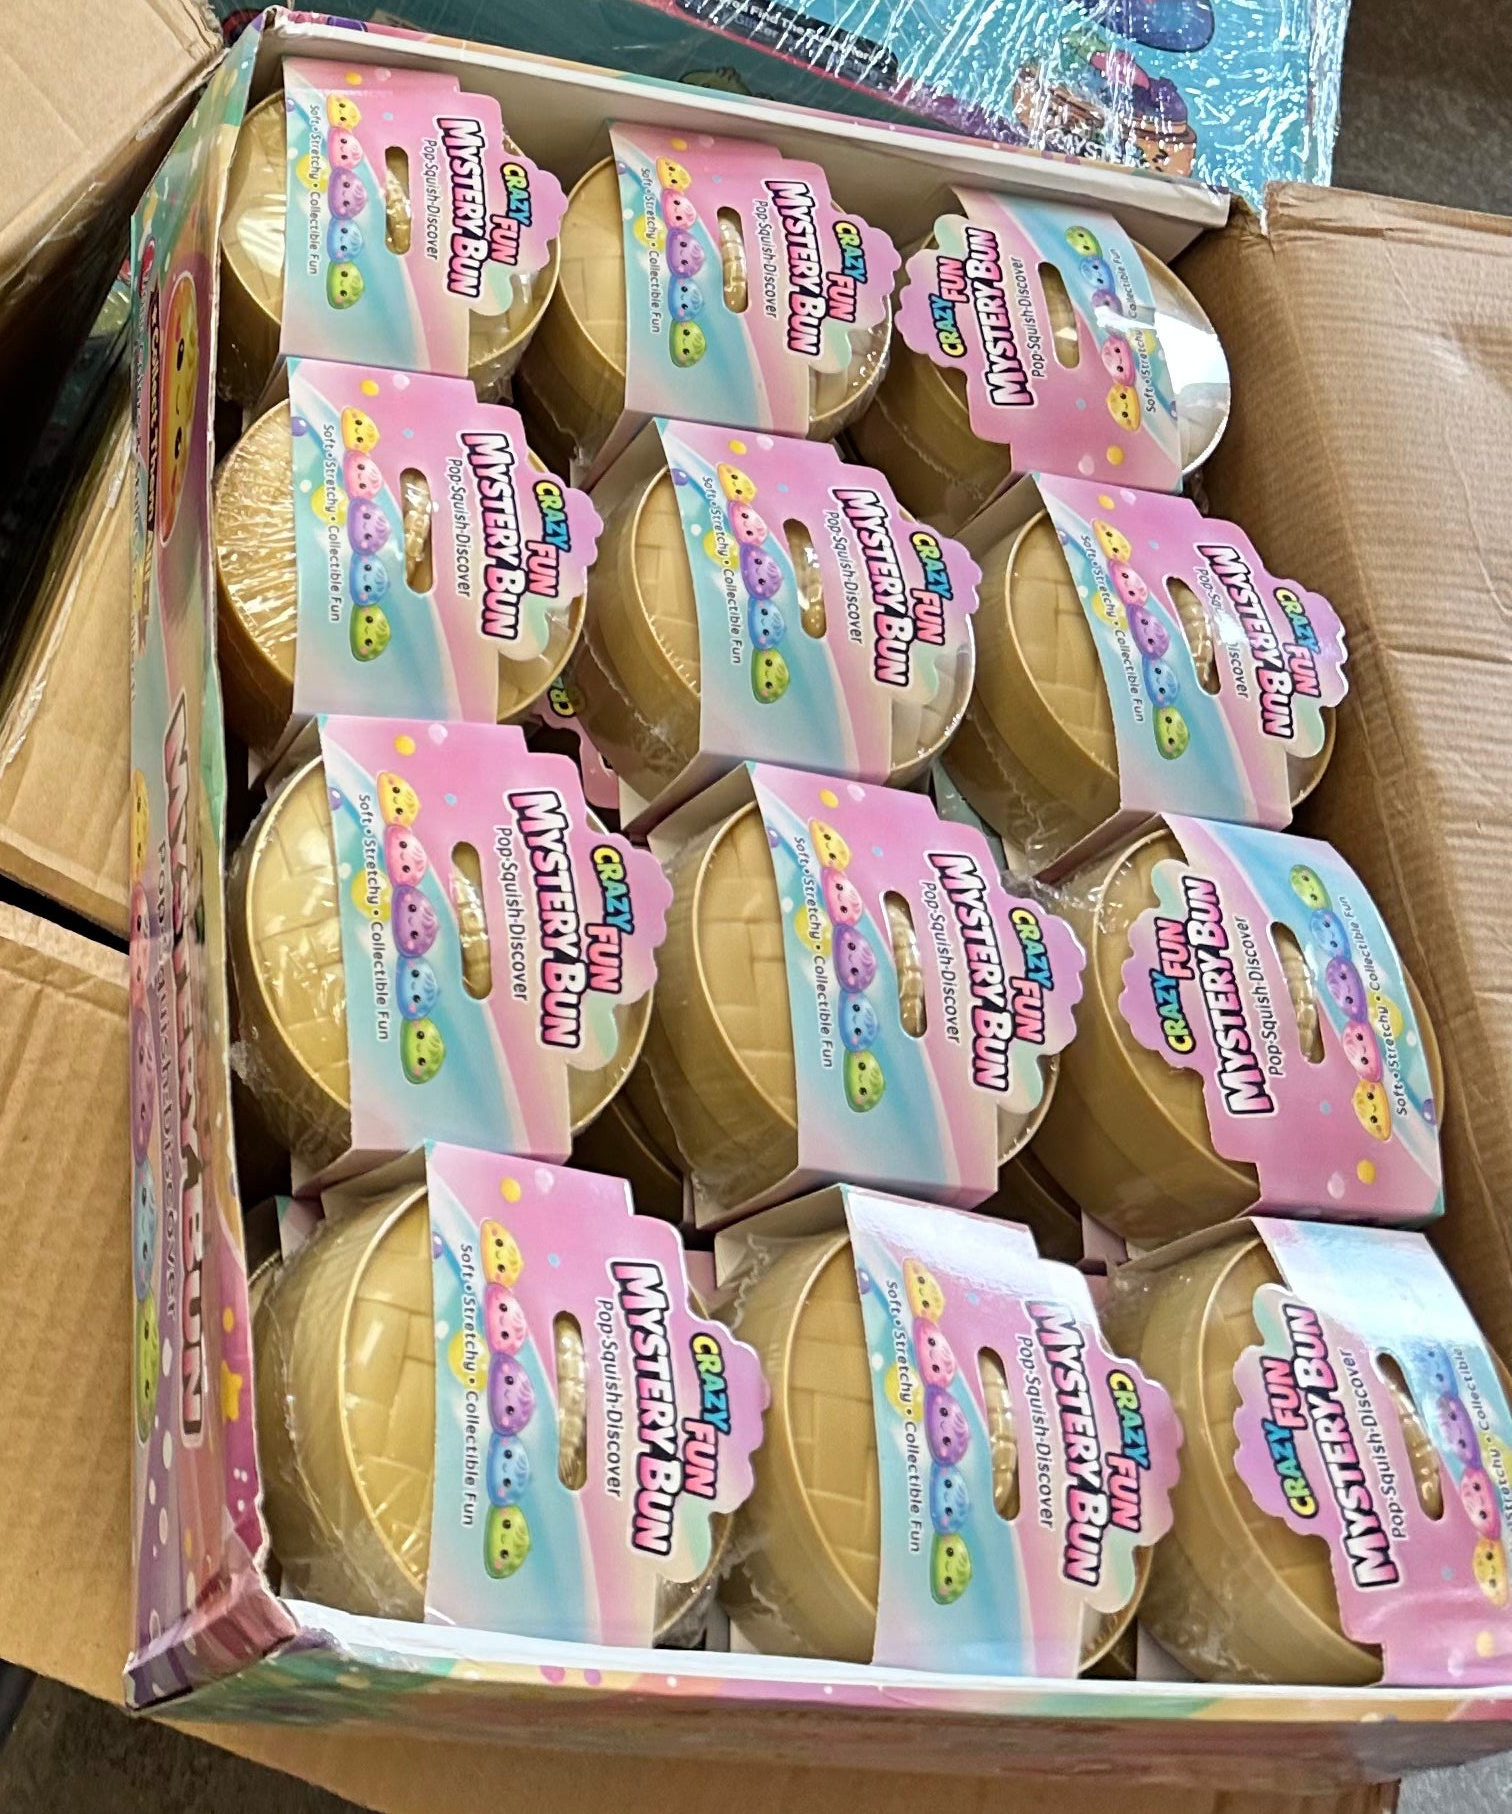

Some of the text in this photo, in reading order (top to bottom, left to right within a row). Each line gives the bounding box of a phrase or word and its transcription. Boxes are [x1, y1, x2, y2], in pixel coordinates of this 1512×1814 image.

[309, 105, 321, 274] Soft Stretchy Collectible Fun
[437, 118, 491, 297] MYSTERY BUN
[490, 214, 520, 266] FUN
[500, 162, 532, 227] CRAZY
[641, 168, 662, 333] Soft Stretchy Collectible Fun
[765, 181, 828, 356] MYSTERY BUN
[826, 272, 857, 323] FUN
[833, 221, 867, 284] CRAZY
[937, 256, 969, 303] FUN
[929, 293, 967, 358] CRAZY
[965, 227, 1034, 406] MYSTERY BUN
[324, 424, 342, 621] Soft Stretchy Collectible Fun
[461, 433, 528, 640] MYSTERY BUN
[533, 480, 571, 552] CRAZY
[909, 532, 953, 601] CRAZY
[526, 540, 559, 598] FUN
[704, 477, 742, 664] Soft Stretchy Collectible Fun
[832, 489, 916, 686] MYSTERY BUN
[910, 588, 945, 645] FUN
[1197, 545, 1285, 672] MYSTERY
[1256, 666, 1294, 739] BUN
[1283, 643, 1322, 698] FUN
[360, 795, 389, 1039] Soft Stretchy Collectible Fun
[508, 790, 588, 1048] MYSTERY BUN
[591, 844, 634, 935] CRAZY
[585, 922, 622, 994] FUN
[795, 837, 833, 1068] Soft Stretchy Collectible Fun
[928, 854, 1013, 1092] MYSTERY BUN
[1008, 907, 1054, 991] CRAZY
[1154, 917, 1195, 981] FUN
[1182, 876, 1274, 1114] MYSTERY BUN
[1010, 976, 1045, 1045] FUN
[1149, 968, 1196, 1055] CRAZY
[181, 1172, 205, 1442] BUN
[461, 1244, 480, 1526] Soft Stretchy Collectible Fun
[611, 1262, 683, 1555] MYSTERY BUN
[690, 1333, 730, 1435] CRAZY
[887, 1282, 923, 1552] Soft Stretchy Collectible Fun
[1107, 1369, 1151, 1471] CRAZY
[1260, 1356, 1308, 1430] FUN
[682, 1418, 718, 1500] FUN
[1026, 1301, 1109, 1587] MYSTERY BUN
[1105, 1452, 1141, 1532] FUN
[1261, 1418, 1319, 1519] CRAZY
[1283, 1304, 1400, 1587] MYSTERY BUN
